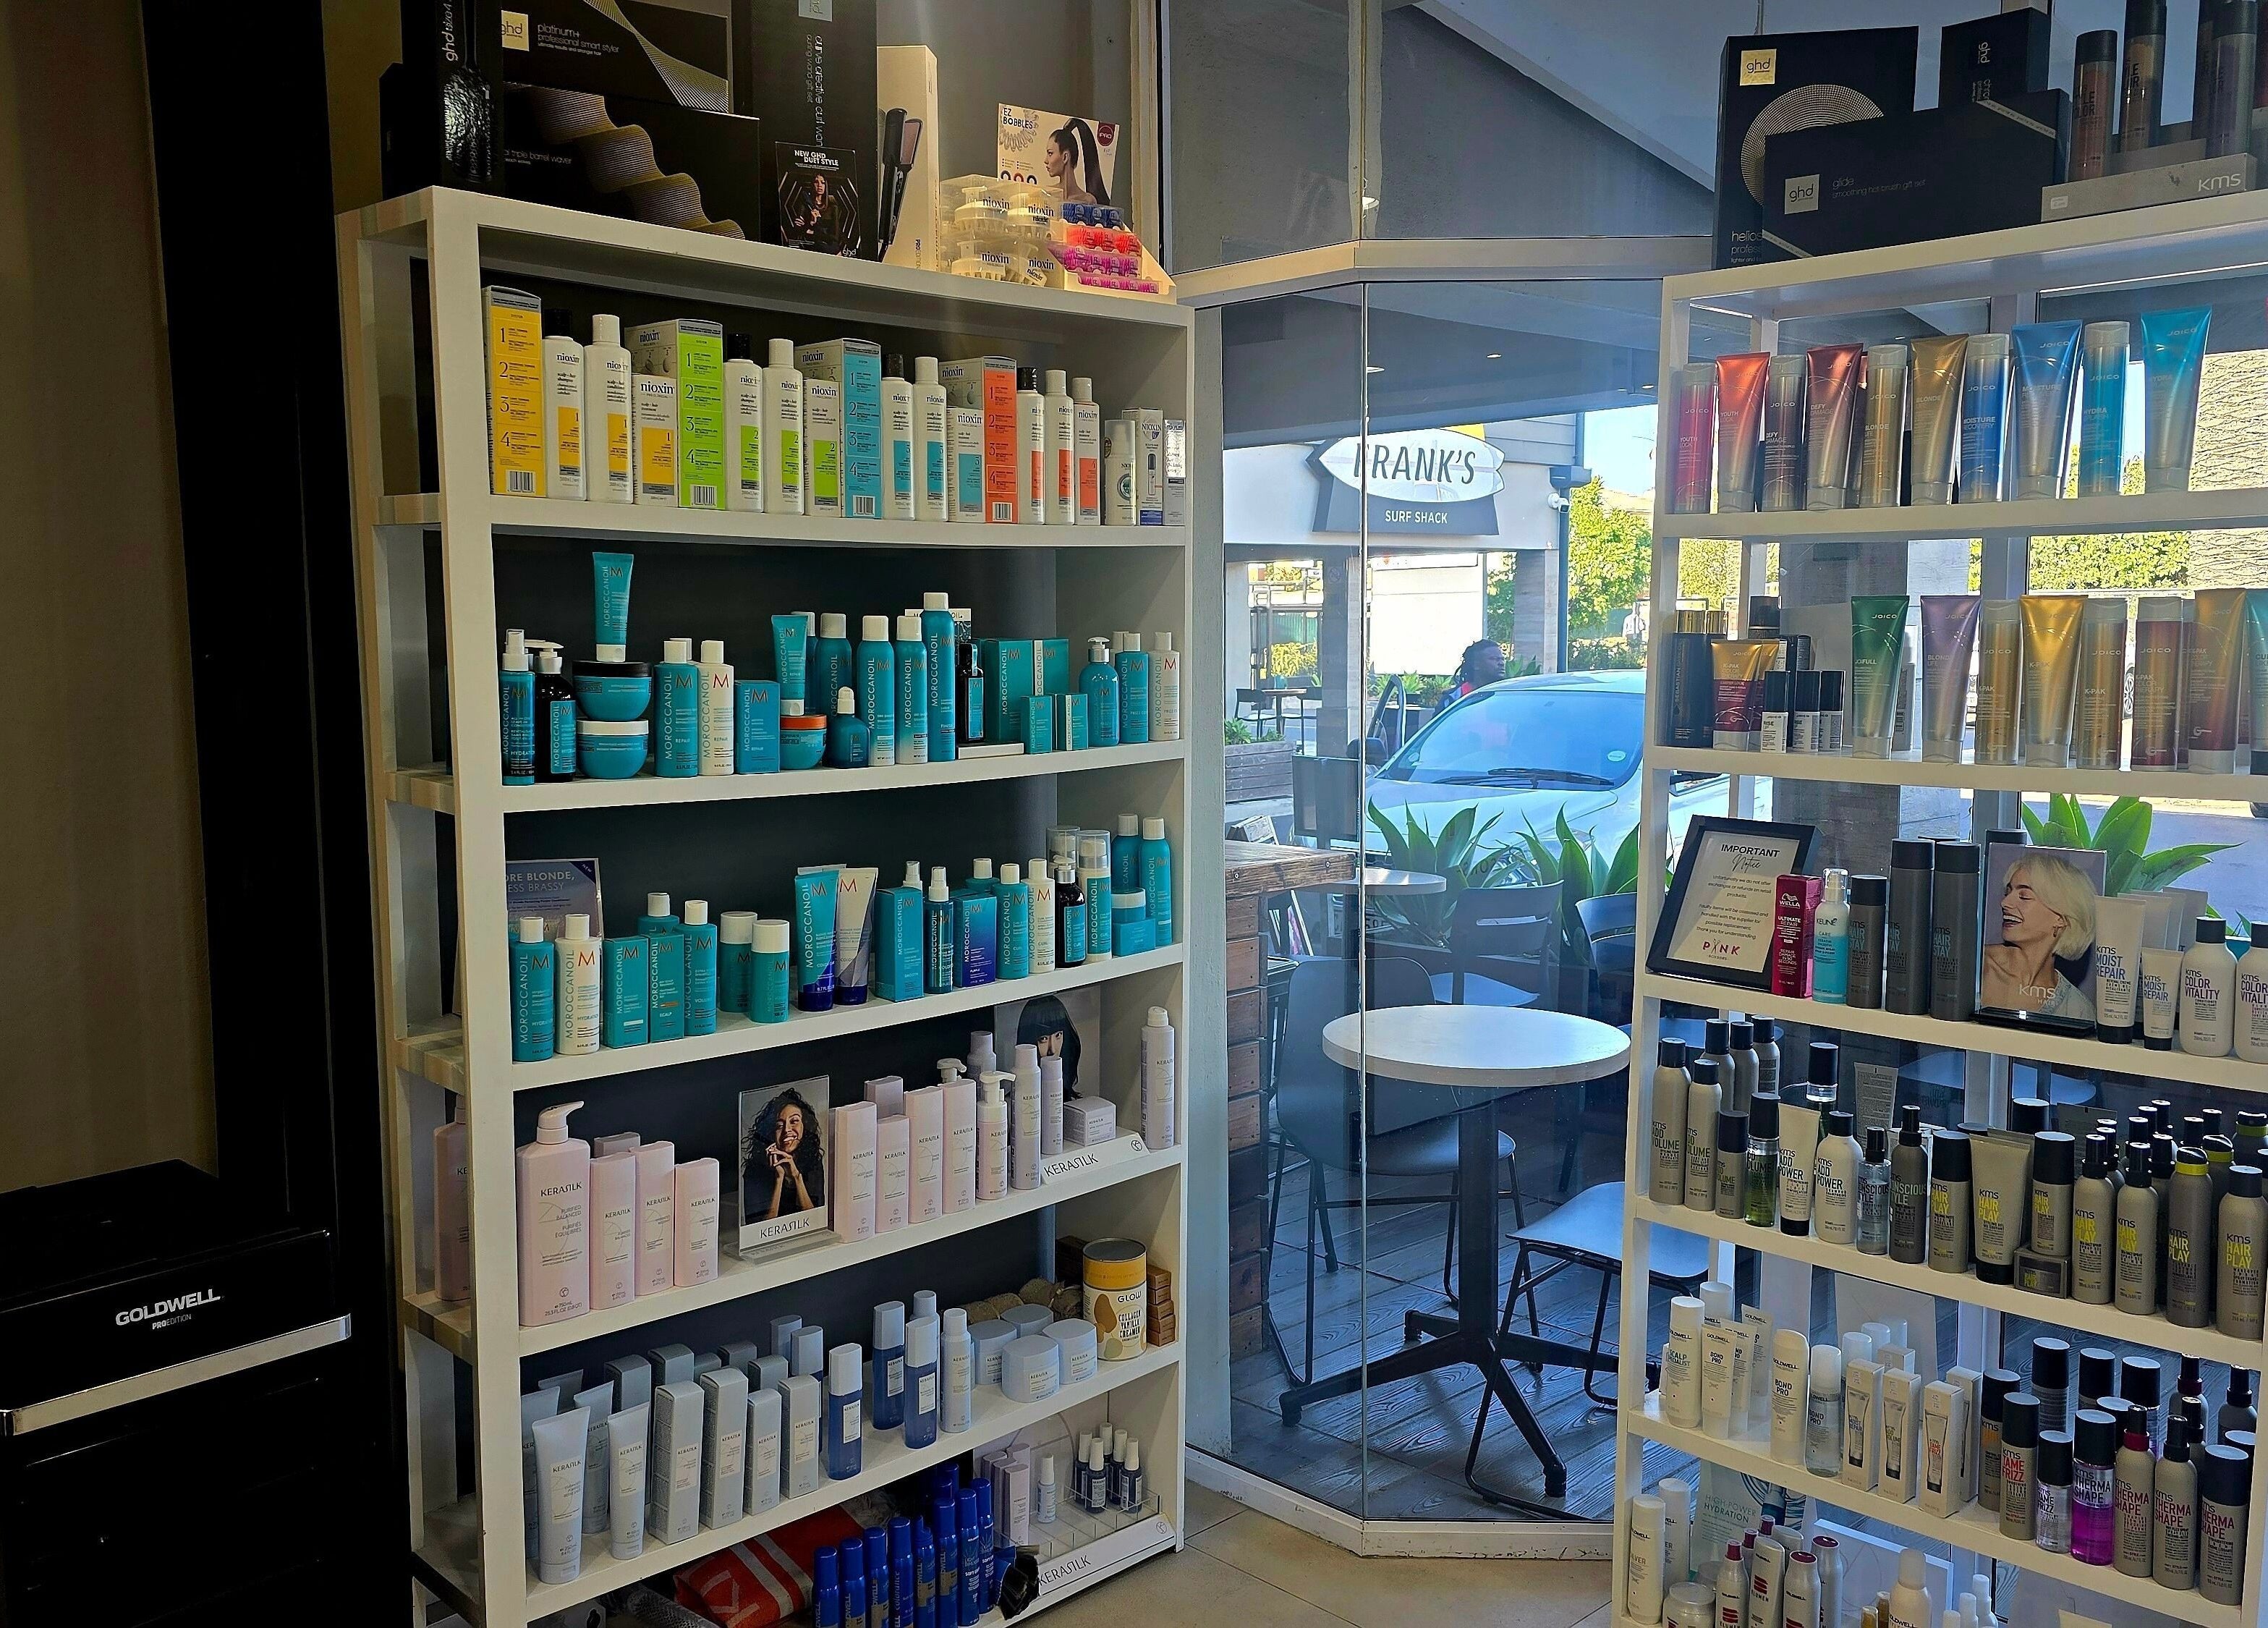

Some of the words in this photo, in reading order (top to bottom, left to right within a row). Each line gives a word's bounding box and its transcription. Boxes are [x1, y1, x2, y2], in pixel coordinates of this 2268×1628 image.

[538, 23, 579, 38] platinum+
[538, 34, 579, 48] professional
[580, 40, 599, 51] smart
[600, 43, 620, 55] styler
[815, 35, 824, 64] curve
[1978, 42, 1990, 64] ghd
[1746, 59, 1771, 75] ghd
[815, 67, 824, 103] creative
[815, 105, 824, 126] curl
[1003, 107, 1012, 117] EZ
[1003, 116, 1034, 130] BOBBLES
[794, 150, 809, 158] NEW
[810, 151, 827, 160] GHD
[804, 156, 820, 165] DUET
[820, 158, 839, 167] STYLE
[2198, 173, 2241, 192] kms
[1789, 185, 1814, 203] ghd
[982, 197, 1011, 210] nioxin
[1028, 204, 1055, 216] nioxin
[1731, 231, 1762, 242] helios
[982, 252, 1010, 265] nioxin
[501, 327, 506, 344] 1
[640, 330, 660, 343] nioxin
[687, 352, 692, 368] 1
[499, 361, 509, 378] 2
[942, 366, 964, 378] nioxin
[641, 382, 674, 395] nioxin
[685, 383, 694, 399] 2
[812, 385, 837, 397] nioxin
[500, 397, 509, 413] 3
[686, 416, 695, 432] 3
[957, 412, 982, 424] nioxin
[1142, 423, 1163, 432] NIOXIN
[501, 431, 511, 448] 4
[686, 449, 695, 464] 4
[1354, 443, 1477, 485] FRANK'S
[1385, 509, 1412, 523] SURF
[1414, 511, 1448, 525] SHACK
[664, 672, 674, 760] MOROCCANOIL
[701, 671, 711, 759] MOROCCANOIL
[1720, 844, 1780, 858] IMPORTANT
[581, 862, 593, 873] NEW
[1732, 854, 1762, 873] Notice
[506, 873, 523, 882] RE
[527, 870, 576, 881] BLONDE,
[508, 883, 524, 893] ESS
[529, 882, 564, 892] BRASSY
[802, 882, 815, 969] MOROCCANOIL
[1933, 946, 1950, 959] STAY
[2096, 946, 2117, 955] kms
[2096, 954, 2123, 967] MOIST
[2096, 967, 2125, 980] REPAIR
[2186, 969, 2202, 978] kms
[2144, 980, 2167, 992] MOIST
[2185, 976, 2211, 989] COLOR
[565, 949, 575, 1040] MOROCCANOIL
[2019, 984, 2056, 999] kms
[2144, 990, 2169, 1001] REPAIR
[2185, 987, 2220, 1001] VITALITY
[519, 954, 529, 1045] MOROCCANOIL
[853, 1150, 875, 1161] KERASILK
[1780, 1148, 1796, 1158] kms
[1044, 1153, 1099, 1177] KERASILK
[1779, 1157, 1793, 1167] ADD
[1817, 1158, 1832, 1166] kms
[1778, 1166, 1804, 1180] POWER
[1817, 1166, 1830, 1177] ADD
[540, 1181, 582, 1197] KERASILK
[1817, 1175, 1843, 1190] POWER
[646, 1195, 671, 1207] KERASILK
[1979, 1189, 2000, 1200] kms
[1979, 1198, 1999, 1211] HAIR
[605, 1208, 632, 1219] KERASILK
[1979, 1209, 2000, 1222] PLAY
[2074, 1208, 2095, 1220] kms
[760, 1217, 810, 1239] KERASILK
[2075, 1218, 2095, 1231] HAIR
[2075, 1229, 2097, 1242] PLAY
[2226, 1233, 2251, 1245] kms
[2226, 1242, 2251, 1256] HAIR
[2225, 1255, 2252, 1269] PLAY
[1117, 1290, 1143, 1303] GLOW
[116, 1289, 221, 1327] GOLDWELL
[153, 1313, 192, 1330] PROEDITION
[1118, 1308, 1142, 1323] COLLAGEN
[1121, 1319, 1141, 1330] VANILLA
[1119, 1328, 1141, 1339] CREAMER
[1707, 1332, 1730, 1344] GOLDWELL
[1670, 1349, 1687, 1360] SCALP
[1710, 1352, 1724, 1360] BOND
[1773, 1358, 1800, 1370] GOLDWELL
[1775, 1378, 1793, 1391] BOND
[1776, 1386, 1789, 1396] PRO
[620, 1445, 642, 1457] KERASILK
[2003, 1448, 2021, 1460] kms
[553, 1459, 582, 1473] KERASILK
[2002, 1458, 2025, 1471] TAME
[2002, 1468, 2025, 1483] FRIZZ
[2074, 1467, 2095, 1480] kms
[2074, 1476, 2111, 1493] THERMA
[2073, 1489, 2104, 1504] SHAPE
[2155, 1488, 2173, 1502] kms
[1704, 1503, 1751, 1524] HYDRATION
[2155, 1501, 2192, 1517] THERMA
[2154, 1512, 2184, 1528] SHAPE
[1037, 1555, 1092, 1587] KERASILK
